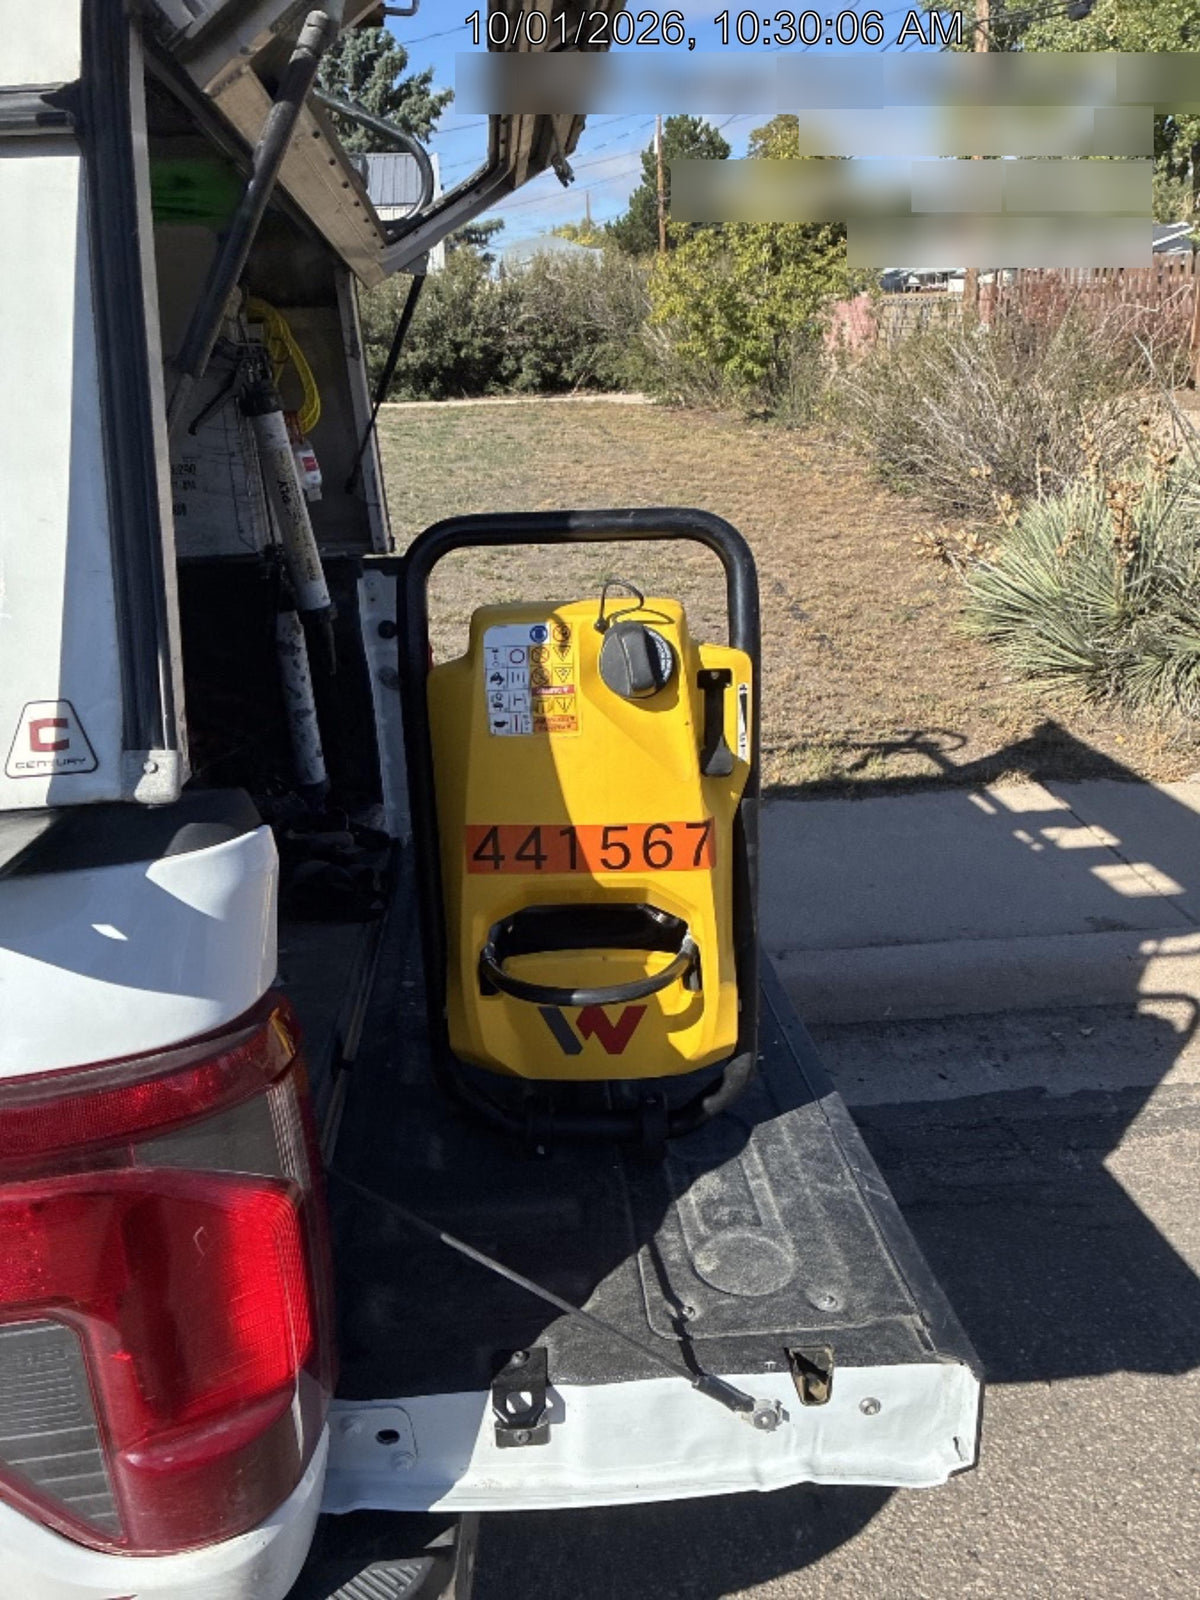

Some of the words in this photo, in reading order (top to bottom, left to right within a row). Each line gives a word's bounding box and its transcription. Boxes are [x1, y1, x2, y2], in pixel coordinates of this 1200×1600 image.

[28, 717, 70, 752] C
[15, 757, 87, 769] CENTURY
[472, 820, 713, 870] 441567
